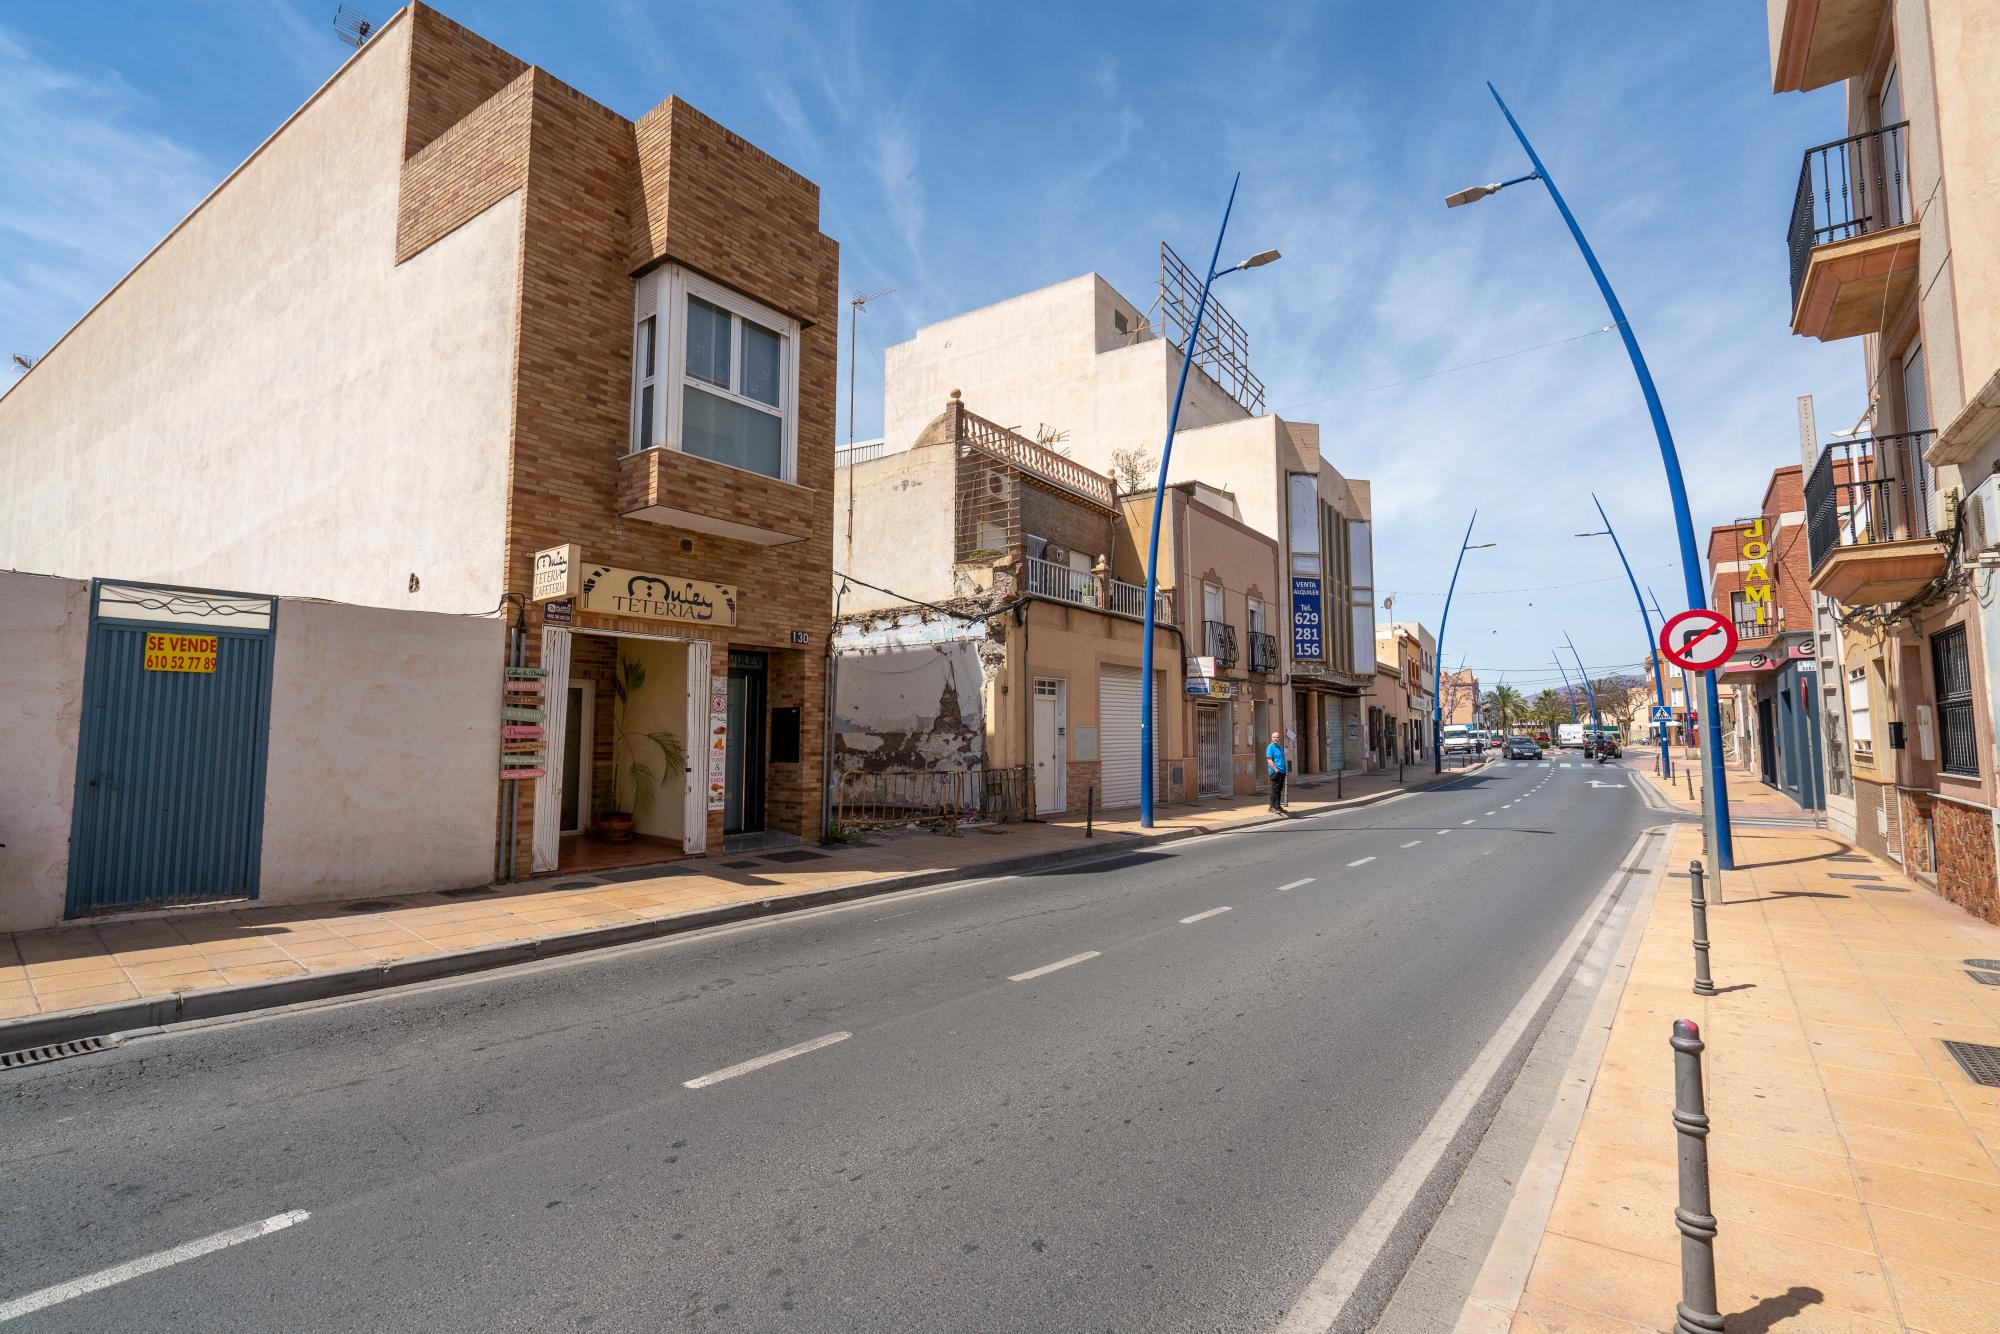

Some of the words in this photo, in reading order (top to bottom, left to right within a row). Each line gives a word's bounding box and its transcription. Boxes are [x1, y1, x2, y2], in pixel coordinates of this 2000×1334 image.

[535, 569, 563, 585] TETERIA
[1743, 518, 1772, 625] JOAMI
[534, 582, 565, 598] CAFETERIA
[1295, 581, 1316, 589] VENTA
[612, 595, 698, 620] TETERIA
[1300, 604, 1313, 612] Tel.
[1294, 612, 1319, 625] 629
[792, 631, 809, 645] 130
[1295, 627, 1319, 641] 281
[148, 635, 165, 651] SE
[169, 637, 217, 653] VENDE
[1296, 643, 1320, 656] 156
[146, 655, 168, 669] 610
[170, 656, 185, 669] 52
[188, 656, 202, 670] 77
[203, 656, 217, 672] 89
[728, 655, 762, 667] MULEY
